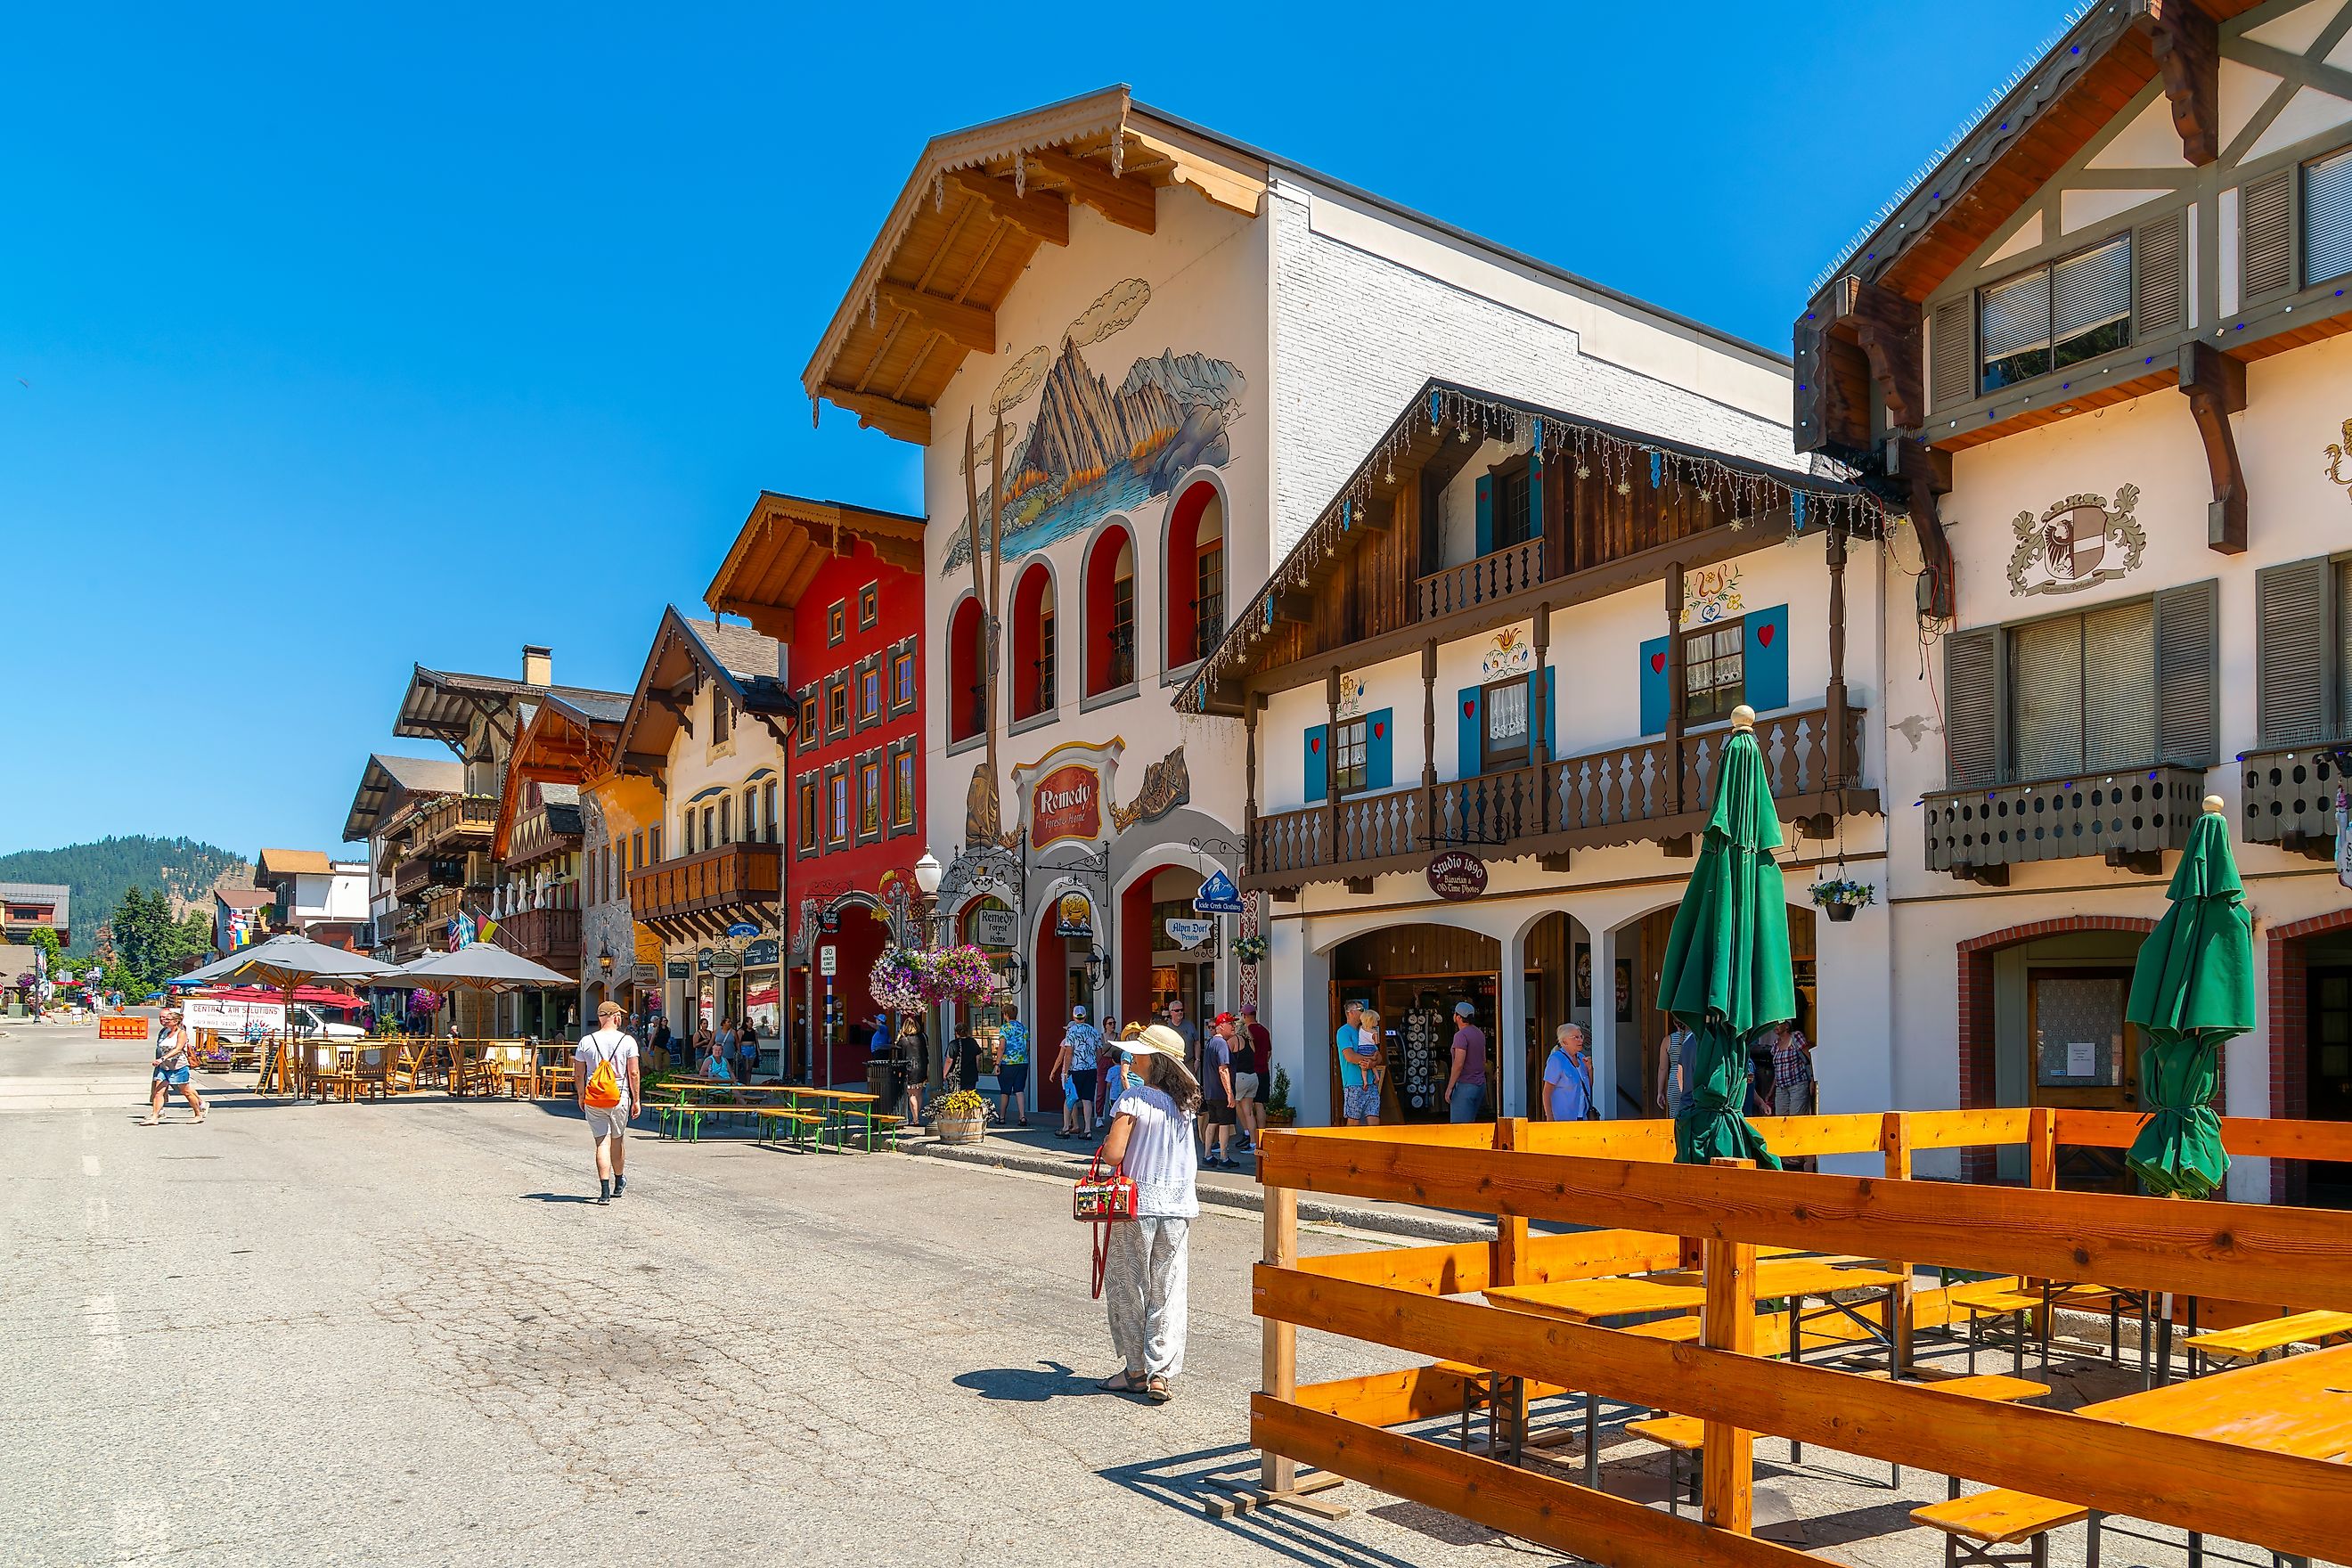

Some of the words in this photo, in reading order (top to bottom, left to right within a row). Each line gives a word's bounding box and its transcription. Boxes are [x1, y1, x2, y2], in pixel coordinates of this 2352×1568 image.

[1041, 783, 1090, 814] Remedy
[1045, 817, 1061, 829] Forest
[1068, 813, 1085, 824] Home
[1432, 854, 1462, 878] Studio
[1464, 858, 1483, 878] 1890
[1444, 874, 1467, 885] Bavarian
[1436, 883, 1448, 892] Old
[1448, 883, 1461, 893] Time
[1461, 884, 1480, 894] Photos
[1210, 902, 1222, 910] Creek
[1222, 902, 1241, 911] Clothing
[982, 911, 1015, 926] Remedy
[988, 923, 1008, 932] Forest
[1172, 922, 1191, 934] Alpen
[1192, 923, 1208, 933] Dorf
[989, 935, 1006, 943] Home
[1181, 933, 1199, 942] Pension
[824, 948, 833, 956] 30
[193, 1005, 224, 1013] CENTRA
